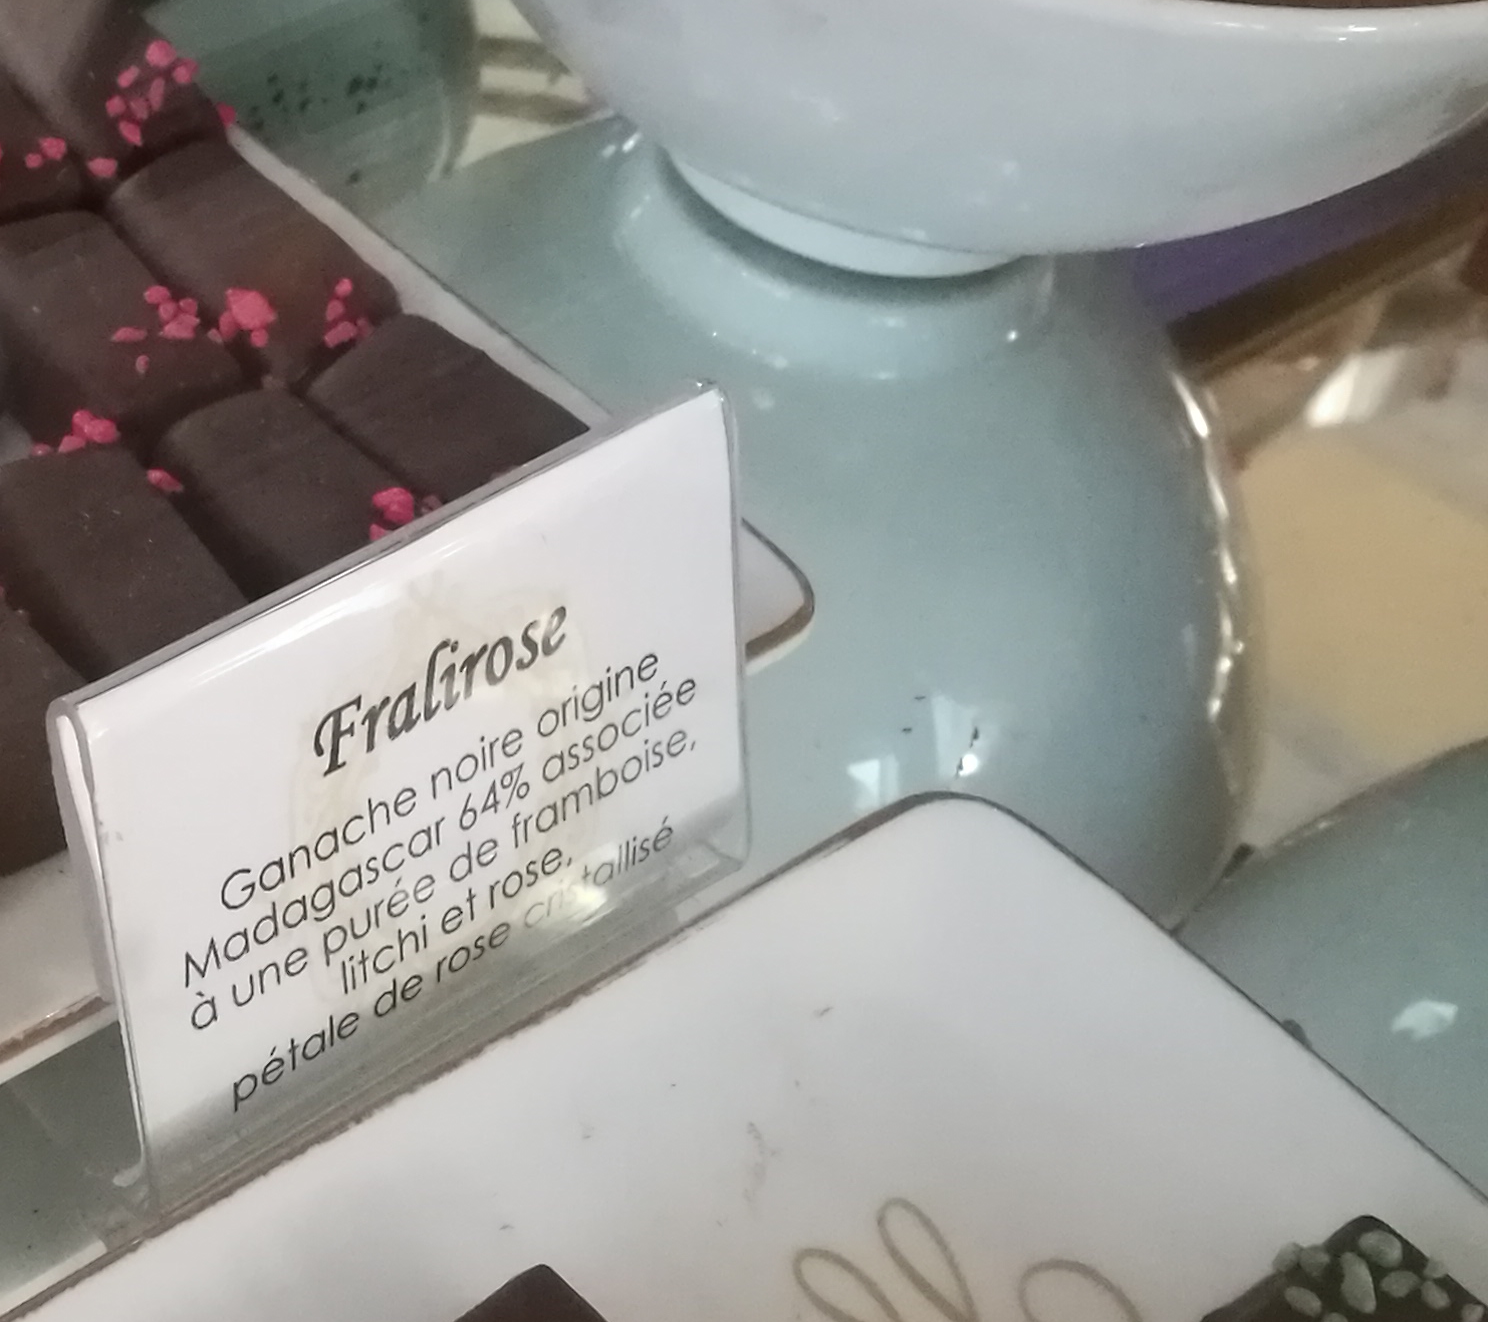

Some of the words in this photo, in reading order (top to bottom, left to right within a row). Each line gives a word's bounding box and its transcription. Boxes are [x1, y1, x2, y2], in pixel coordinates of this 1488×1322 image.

[221, 787, 416, 910] Ganache
[431, 729, 523, 800] noire
[538, 653, 659, 737] origine
[314, 605, 566, 777] Fralirose
[185, 817, 445, 988] Madagascar
[459, 762, 530, 831] 64%
[543, 678, 696, 783] associée
[191, 991, 218, 1030] à
[232, 947, 308, 1007] une
[323, 875, 435, 967] purée
[450, 839, 498, 882] de
[512, 730, 695, 849] framboise,
[342, 924, 427, 994] litchi
[441, 888, 476, 934] et
[490, 848, 572, 909] rose,
[233, 1012, 360, 1114] pétale
[374, 975, 423, 1018] de
[436, 923, 511, 984] rose
